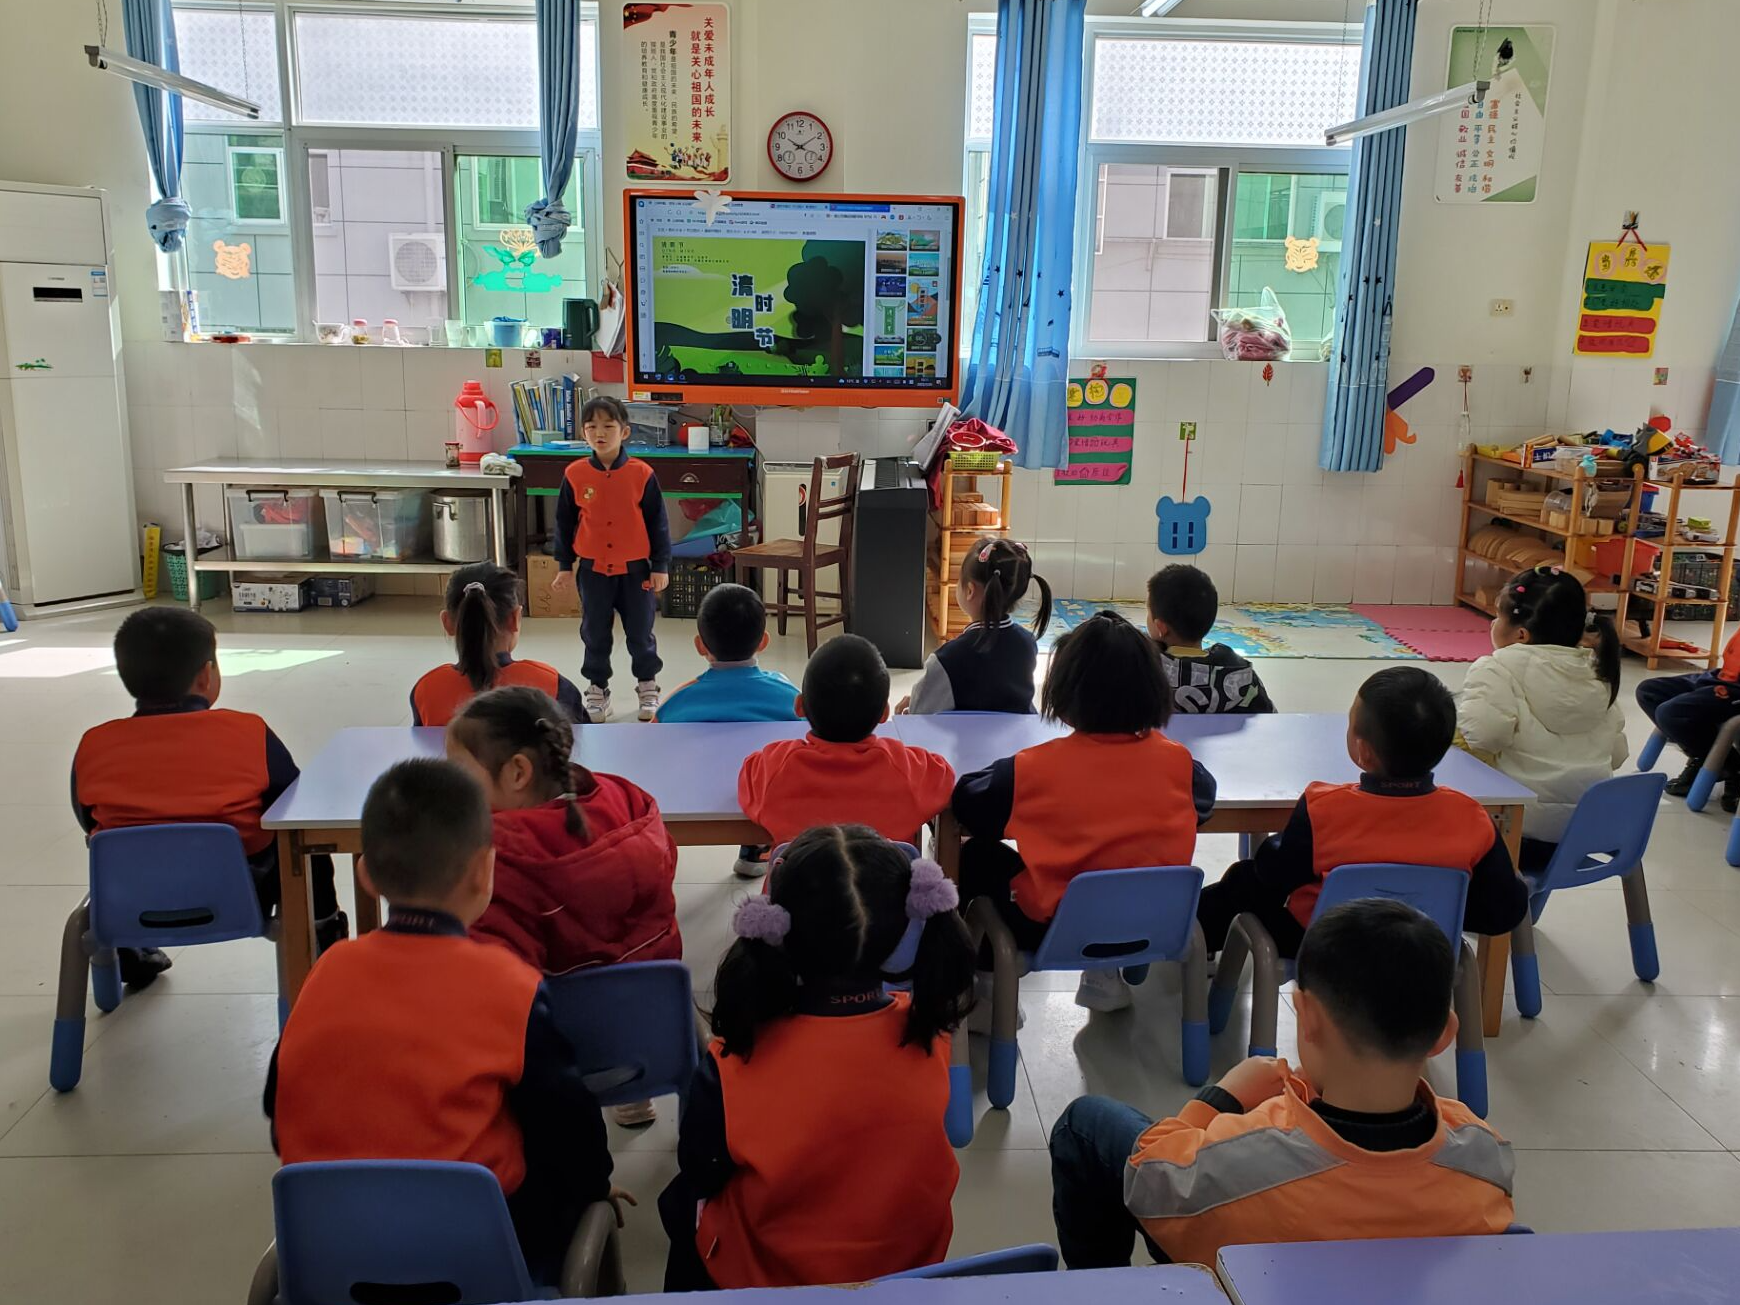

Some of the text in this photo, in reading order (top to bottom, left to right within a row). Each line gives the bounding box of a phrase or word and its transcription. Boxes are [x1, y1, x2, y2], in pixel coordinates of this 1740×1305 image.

[703, 17, 715, 118] 关爱未成年人成长
[691, 30, 702, 143] 就是关心祖国的未来
[787, 123, 794, 131] 11
[809, 123, 813, 131] 1
[1458, 124, 1469, 143] 敬业
[1473, 125, 1482, 144] 平等
[775, 143, 780, 151] 9
[820, 143, 825, 151] 3
[1481, 99, 1500, 193] 富强 民主 文明 和谐
[1455, 149, 1467, 168] 诚信
[1469, 149, 1480, 168] 公正
[1454, 174, 1463, 193] 友善
[1467, 174, 1477, 193] 法治
